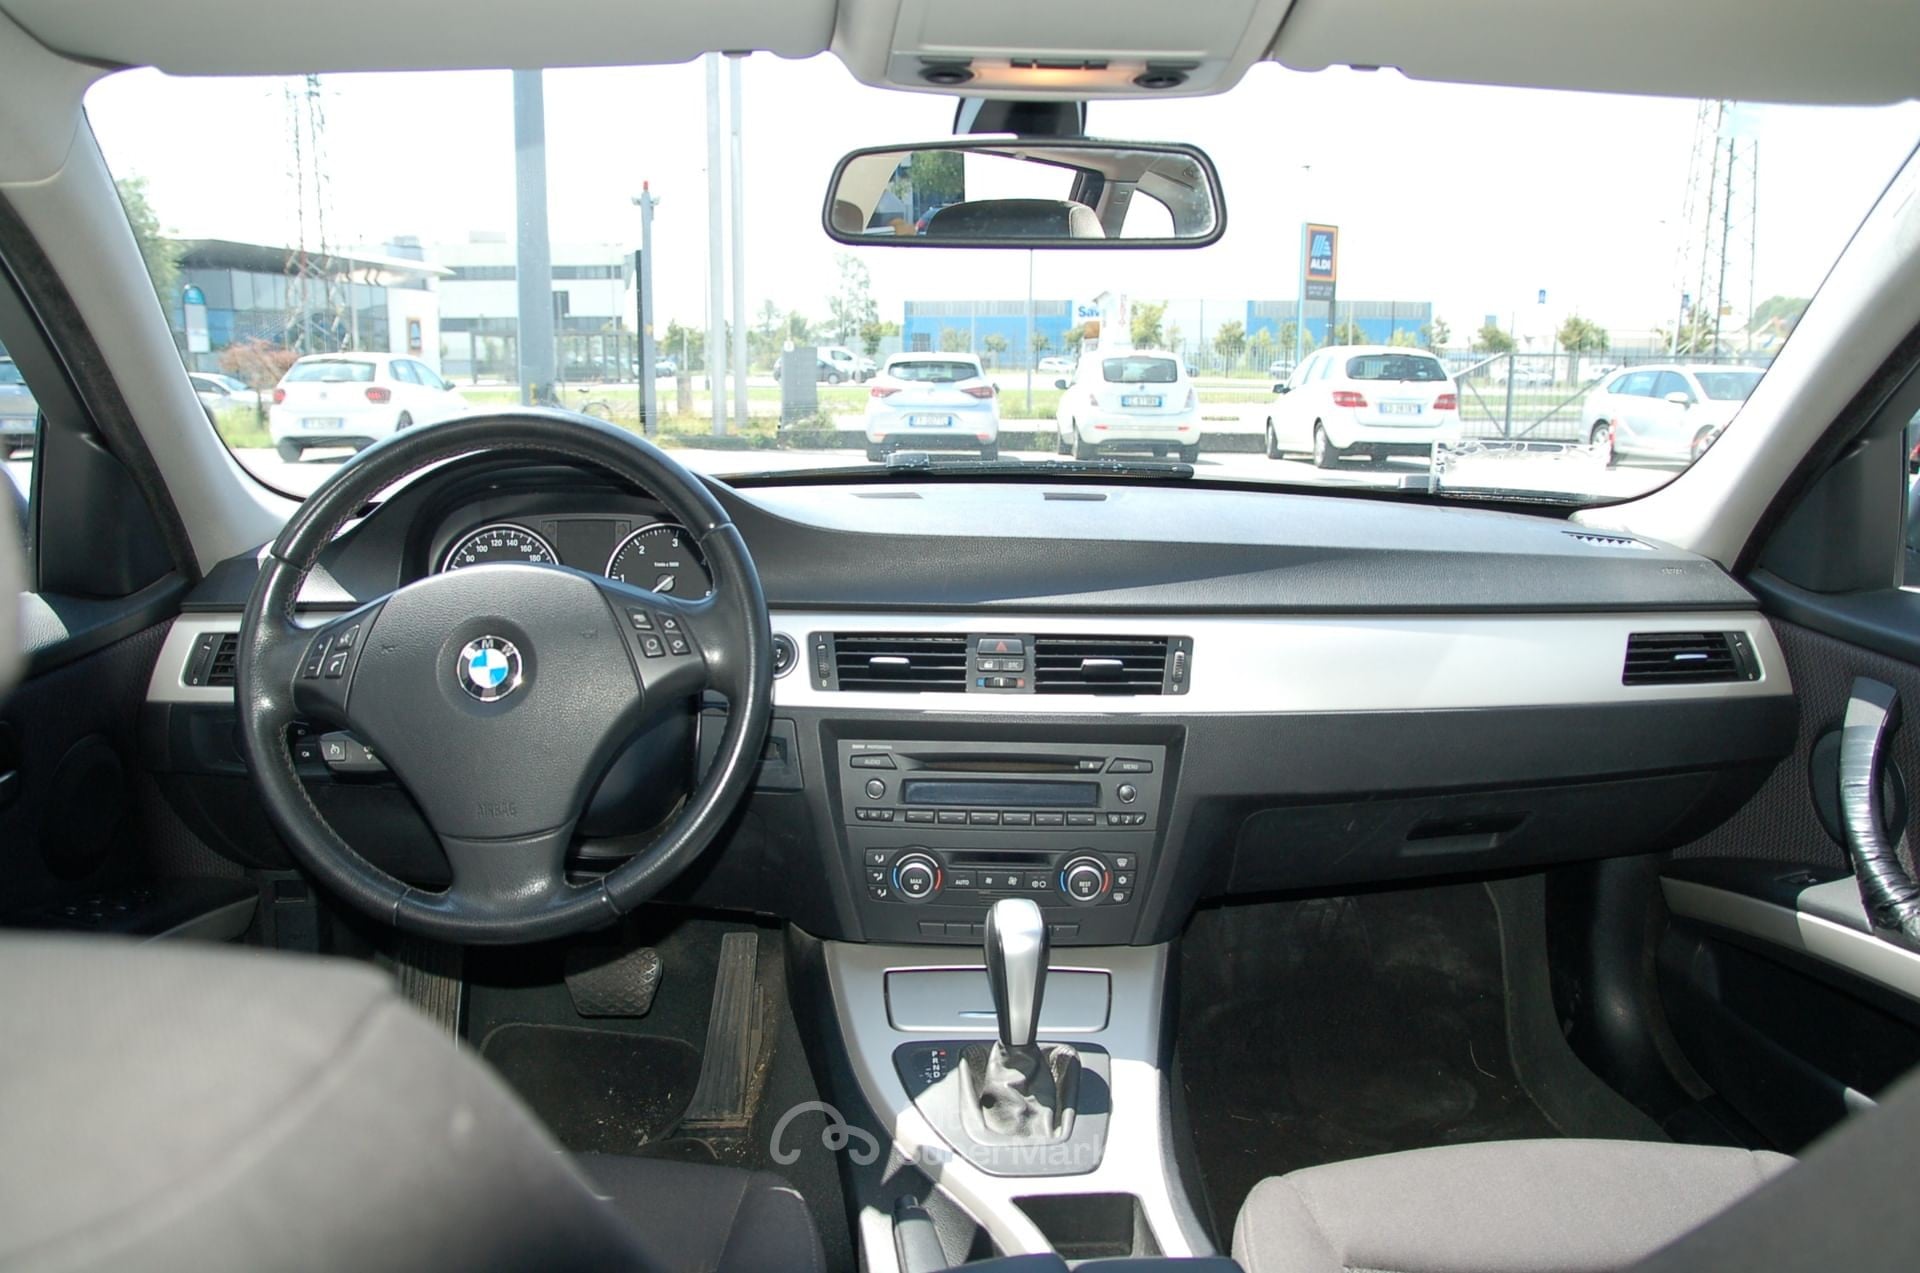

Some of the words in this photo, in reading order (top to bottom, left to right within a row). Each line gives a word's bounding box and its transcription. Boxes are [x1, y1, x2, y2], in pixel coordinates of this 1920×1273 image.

[1310, 258, 1331, 270] ALDI
[491, 539, 502, 547] 120
[506, 539, 518, 547] 140
[672, 538, 678, 547] 3
[639, 545, 645, 554] 2
